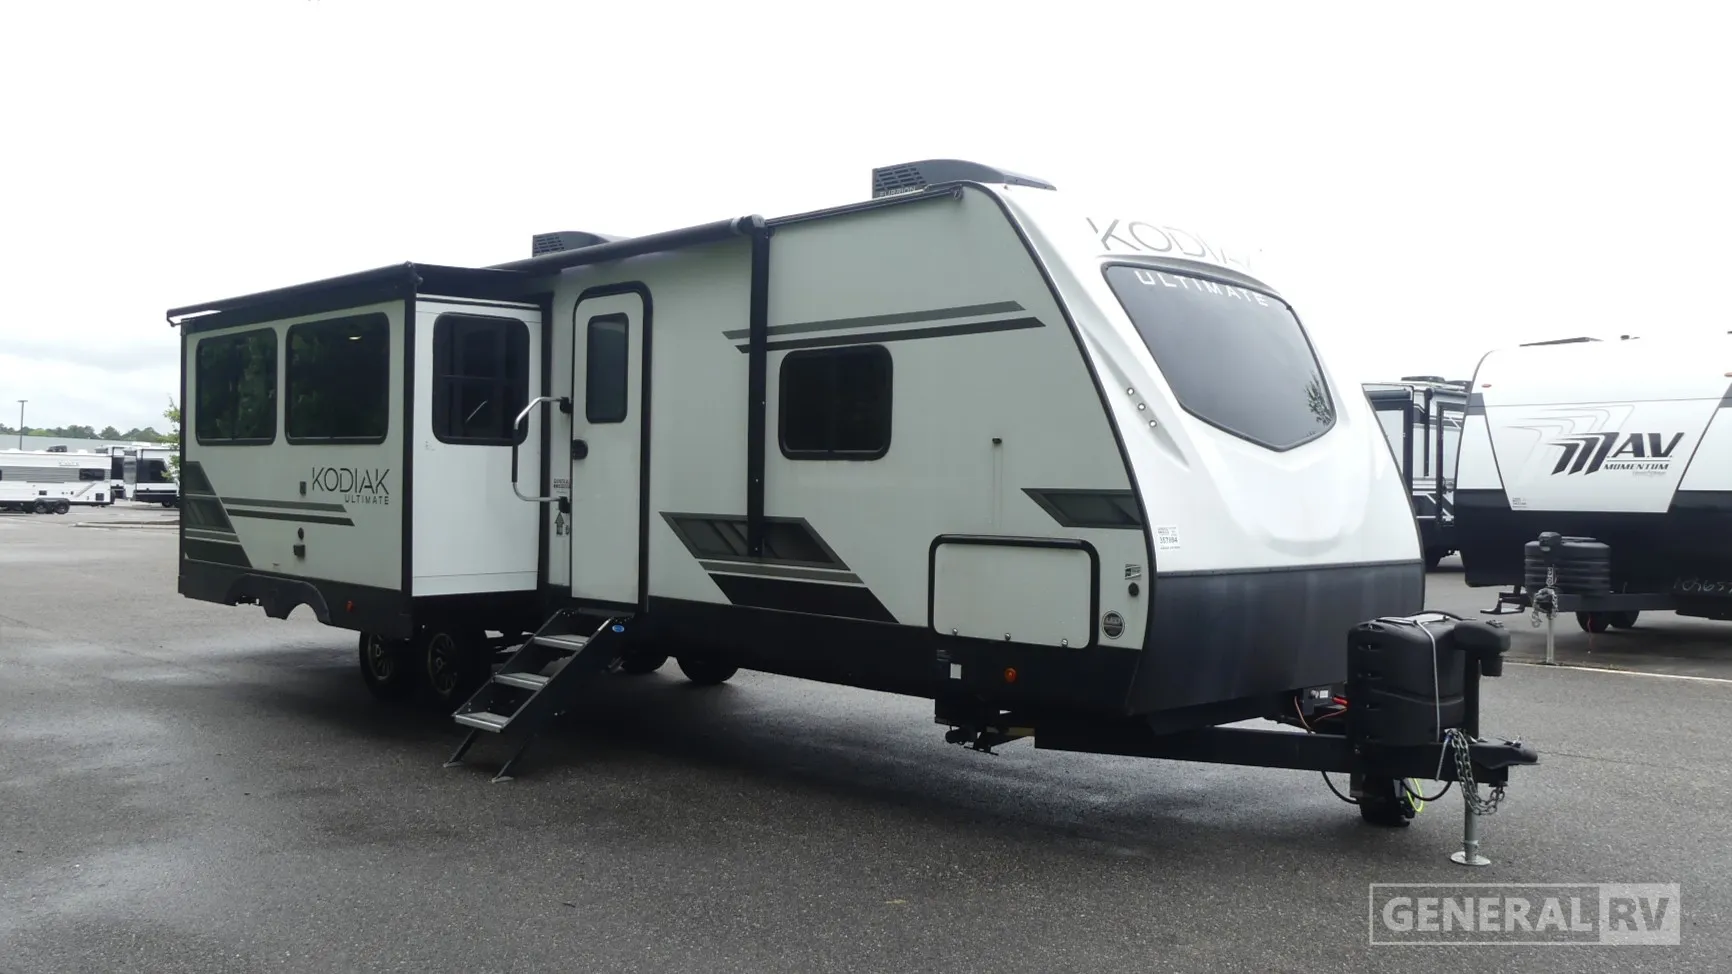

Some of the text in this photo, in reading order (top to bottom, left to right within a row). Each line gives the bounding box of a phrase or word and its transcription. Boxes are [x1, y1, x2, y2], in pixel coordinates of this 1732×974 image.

[1085, 216, 1262, 273] KODIA
[1133, 270, 1269, 307] ULTIMATE
[312, 466, 390, 495] KODIAK
[1603, 463, 1669, 471] MOMENTUM
[344, 495, 389, 505] ULTIMATE
